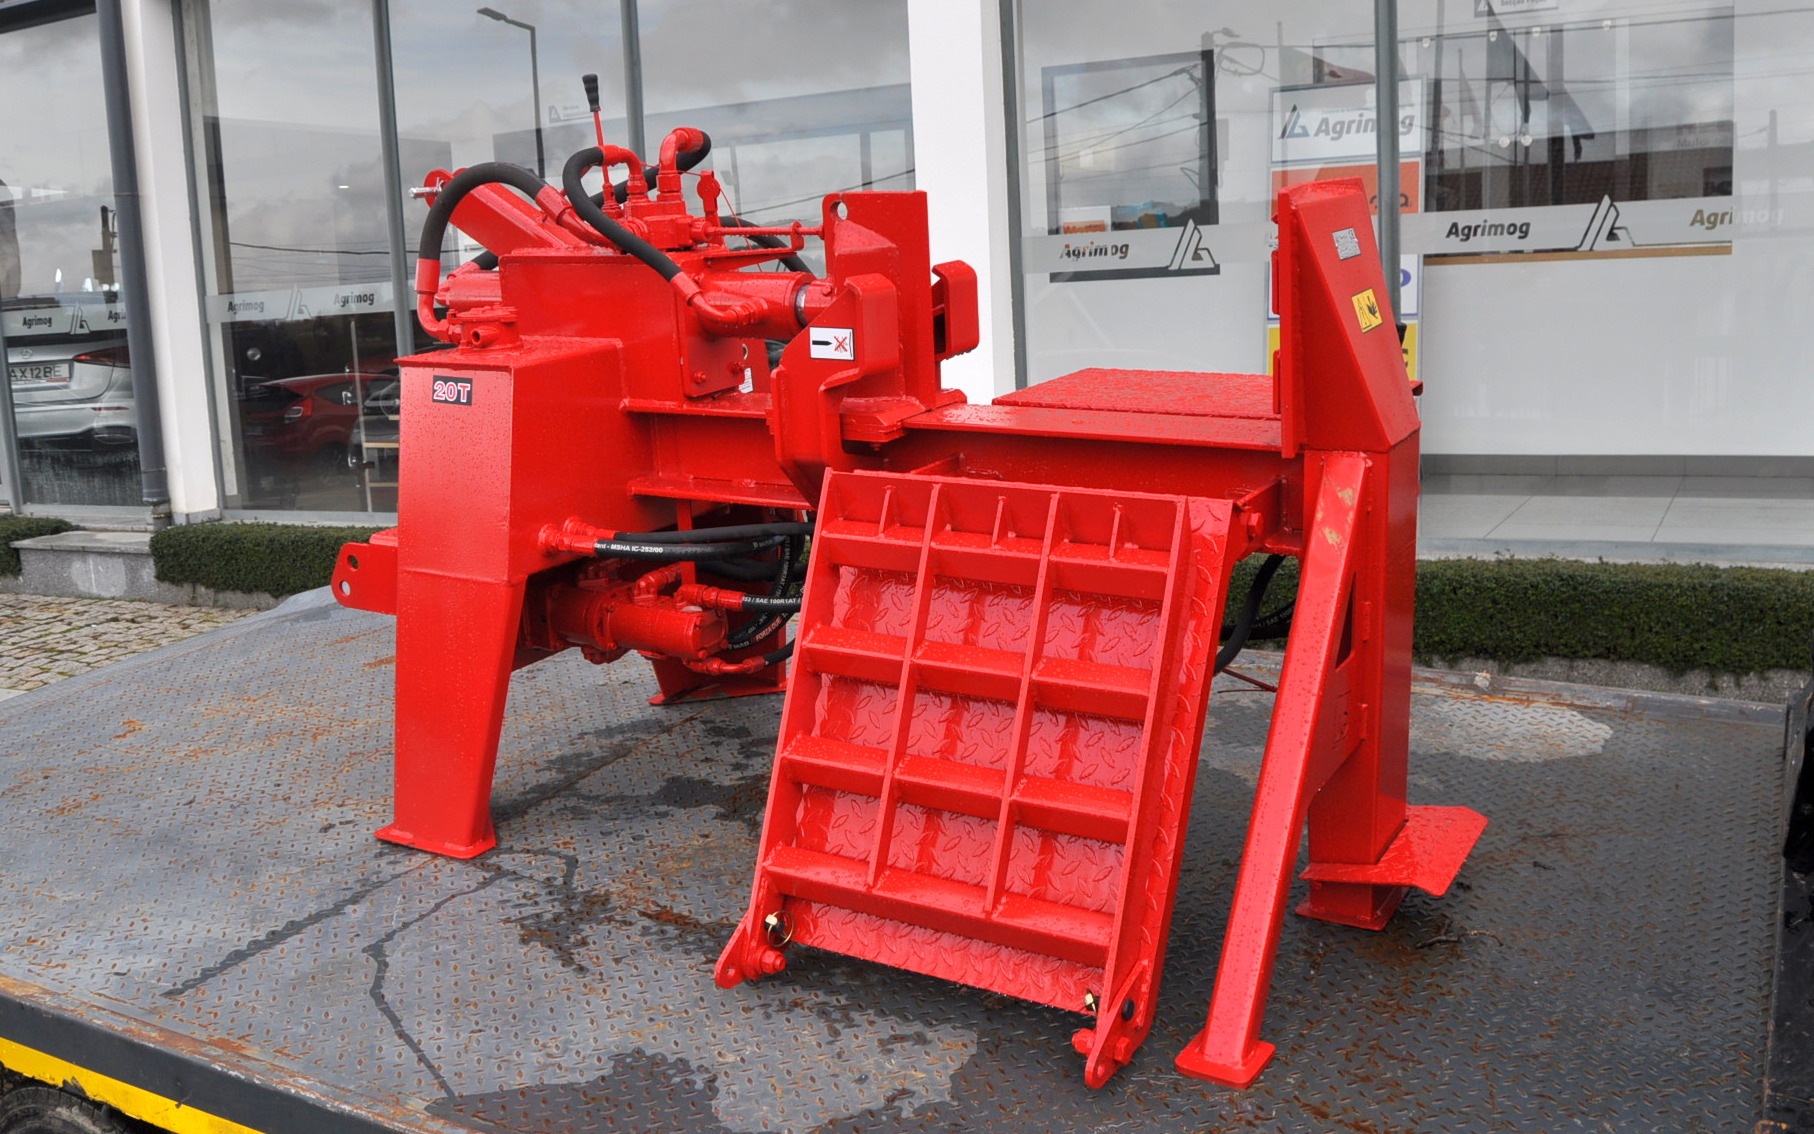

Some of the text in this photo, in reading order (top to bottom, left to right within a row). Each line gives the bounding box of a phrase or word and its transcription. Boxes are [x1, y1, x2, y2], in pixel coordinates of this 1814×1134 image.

[1313, 112, 1416, 141] Agrimg
[1445, 219, 1531, 242] Agrimog
[1060, 241, 1130, 260] Agrimog
[227, 299, 264, 314] Agrimog
[334, 292, 375, 307] Agrimog
[22, 315, 52, 329] Agrimog
[433, 381, 471, 403] 20T
